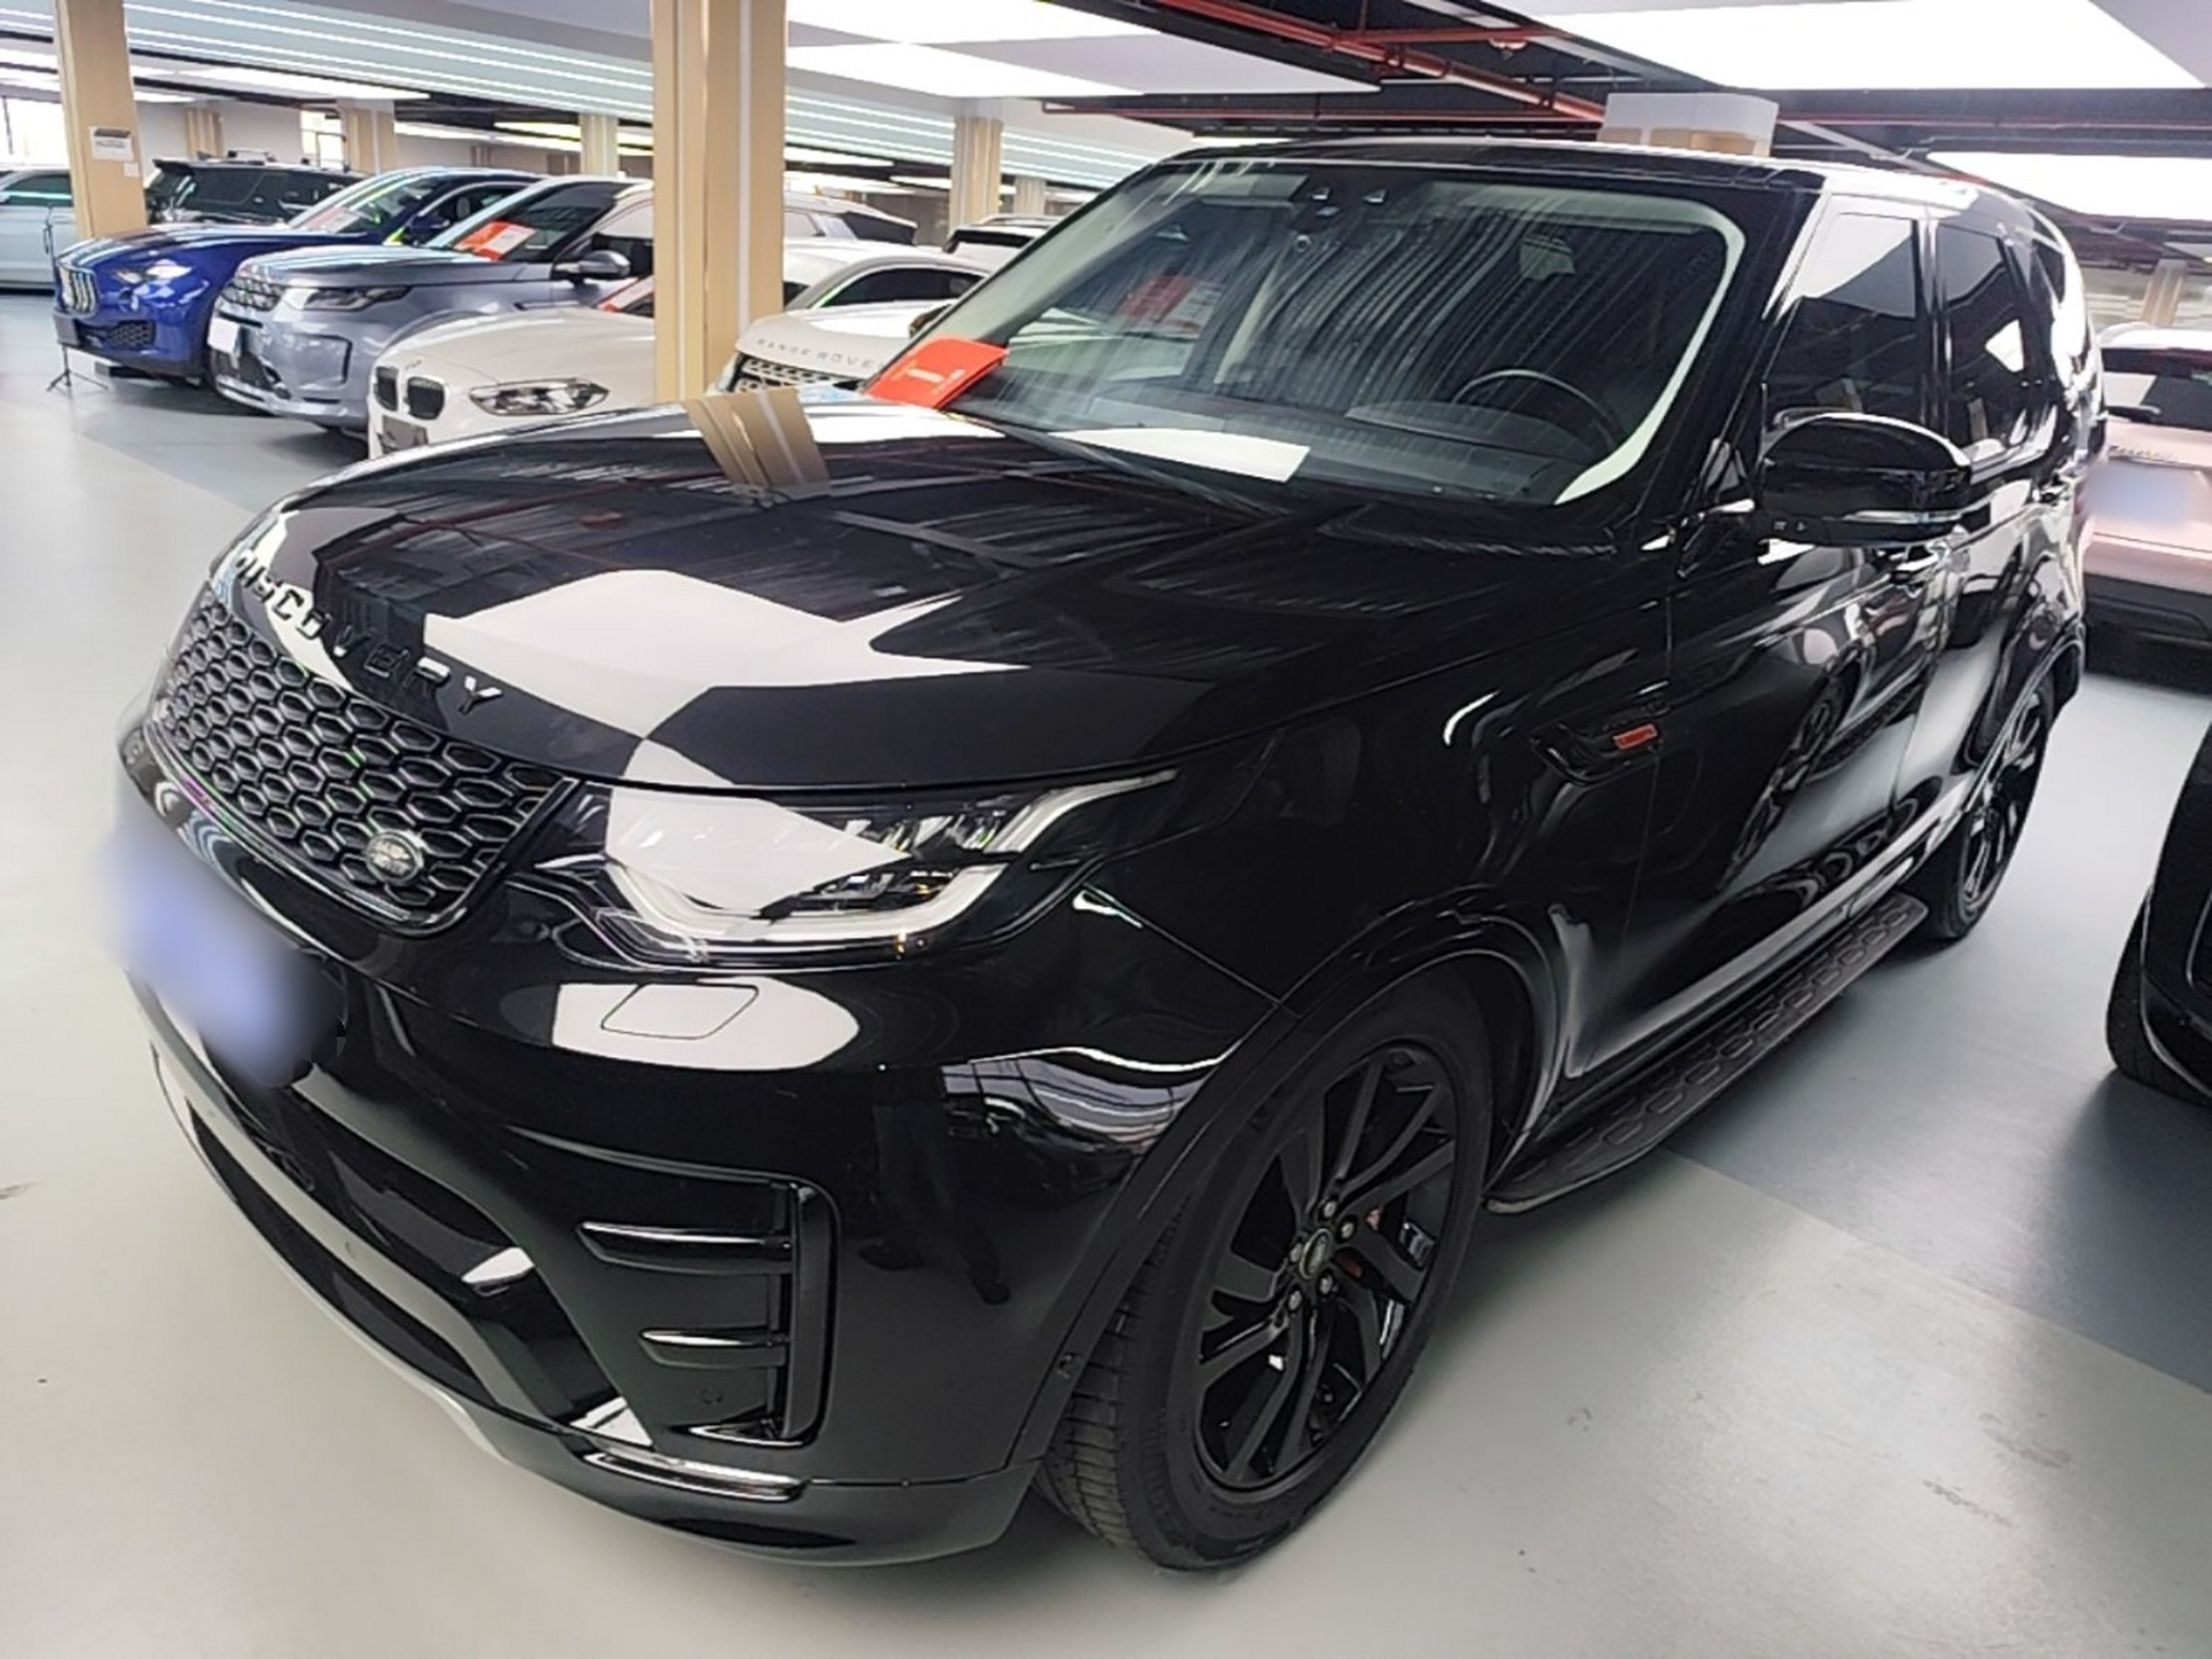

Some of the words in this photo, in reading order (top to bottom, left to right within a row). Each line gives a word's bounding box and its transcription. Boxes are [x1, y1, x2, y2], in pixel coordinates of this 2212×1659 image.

[756, 338, 811, 355] RANGE
[816, 351, 884, 369] ROVE
[236, 551, 503, 716] DISCOVERY
